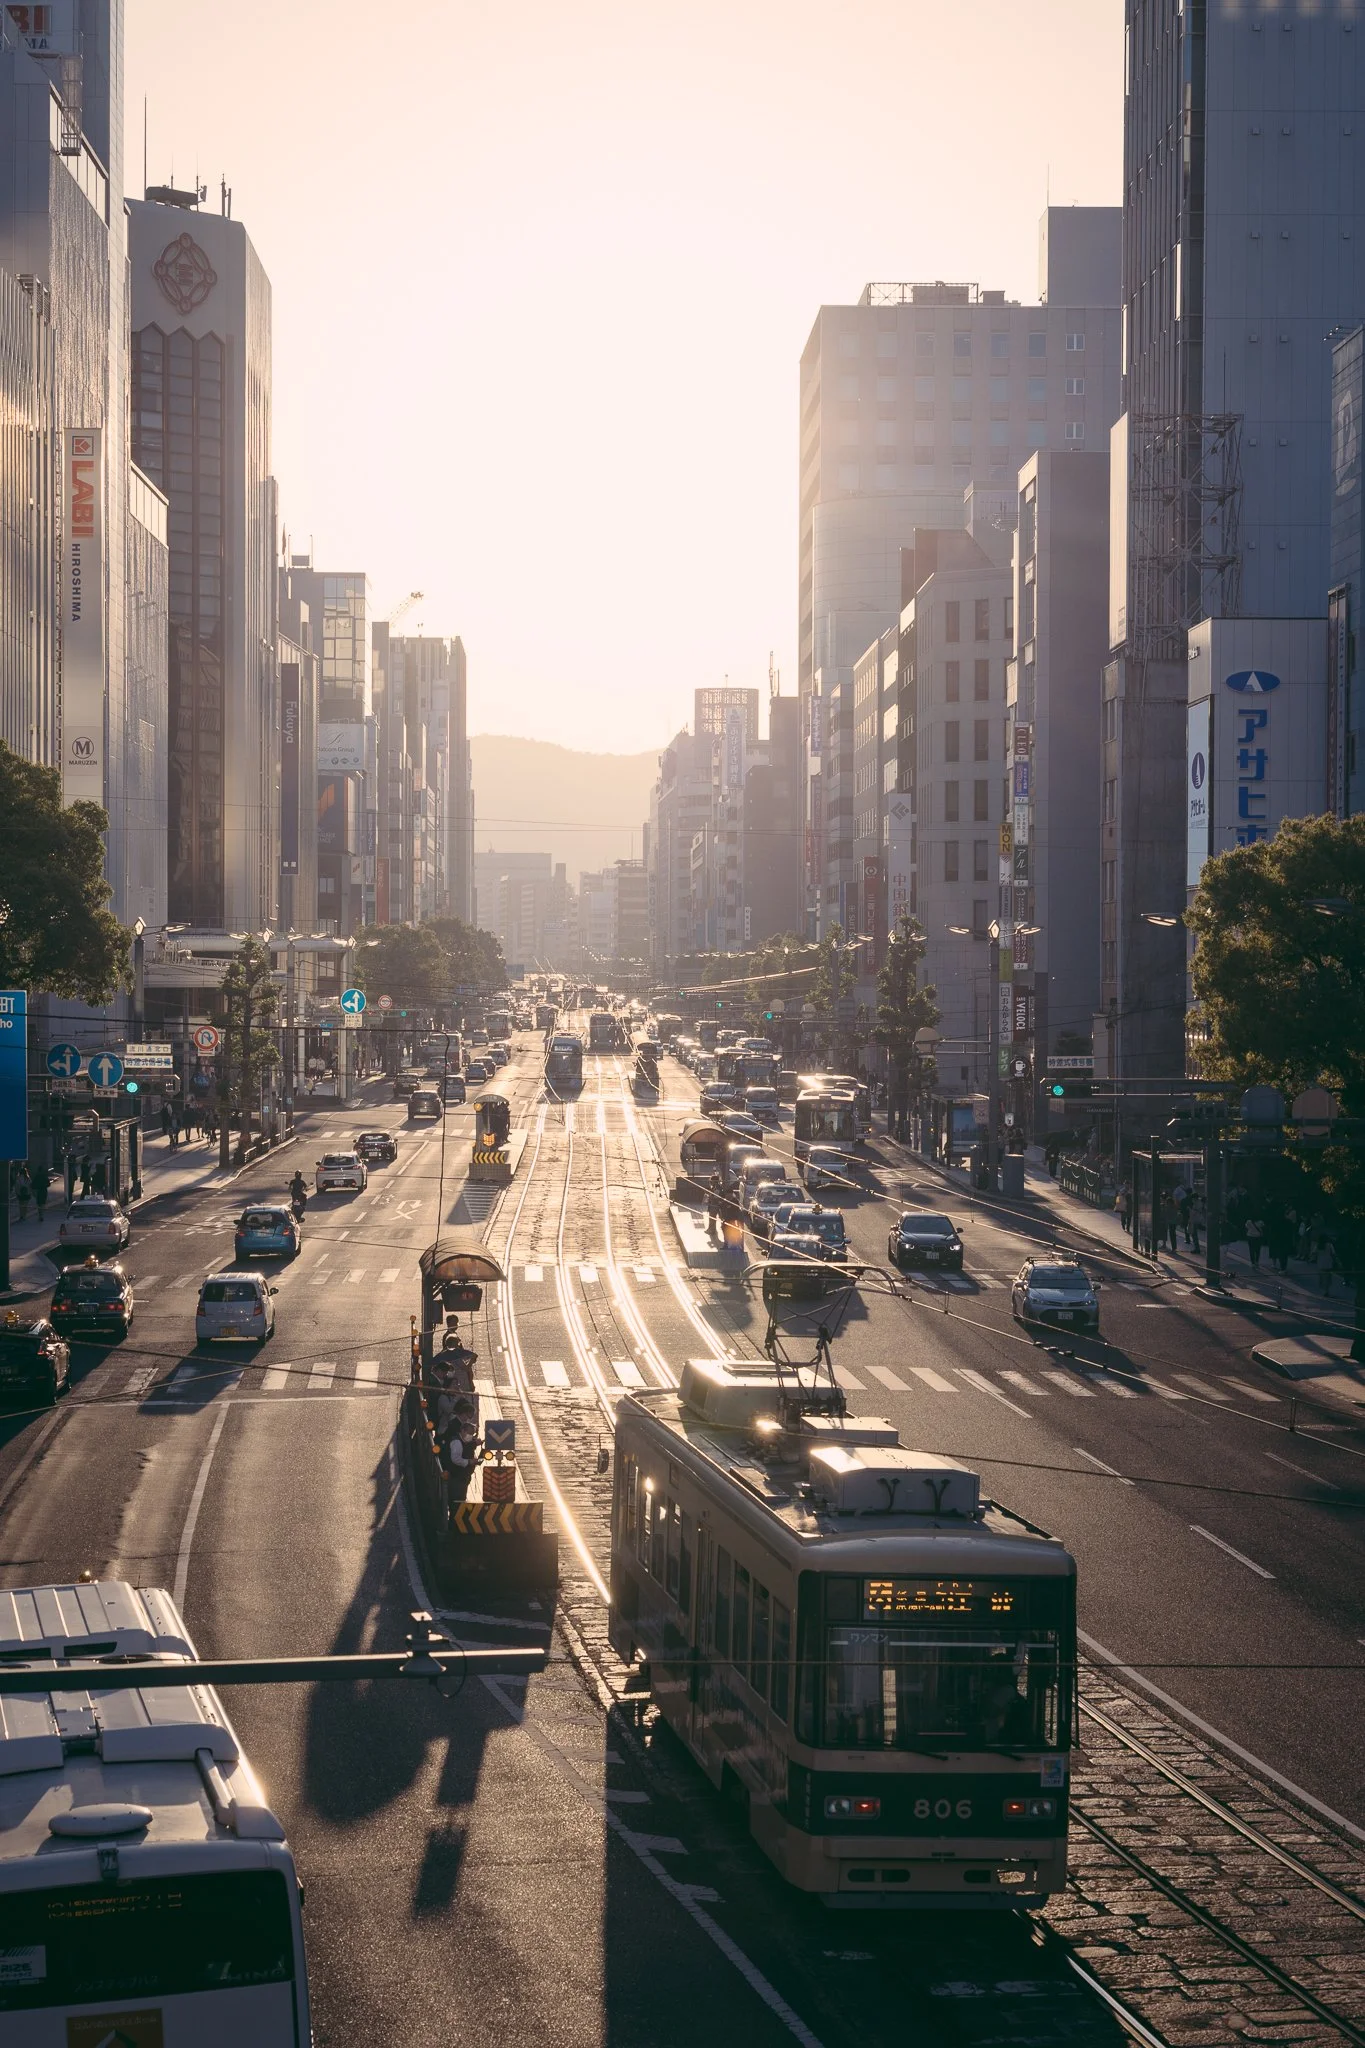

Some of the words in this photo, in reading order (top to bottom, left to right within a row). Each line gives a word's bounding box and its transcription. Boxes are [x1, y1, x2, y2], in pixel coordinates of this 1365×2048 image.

[72, 461, 94, 538] LABI
[72, 543, 81, 622] HIROSHIMA
[283, 701, 298, 744] Fukuya
[1016, 729, 1027, 753] CLEO
[1002, 825, 1012, 852] MON
[1001, 1051, 1009, 1072] レイク
[850, 1633, 889, 1643] ワンマン
[913, 1799, 973, 1819] 806
